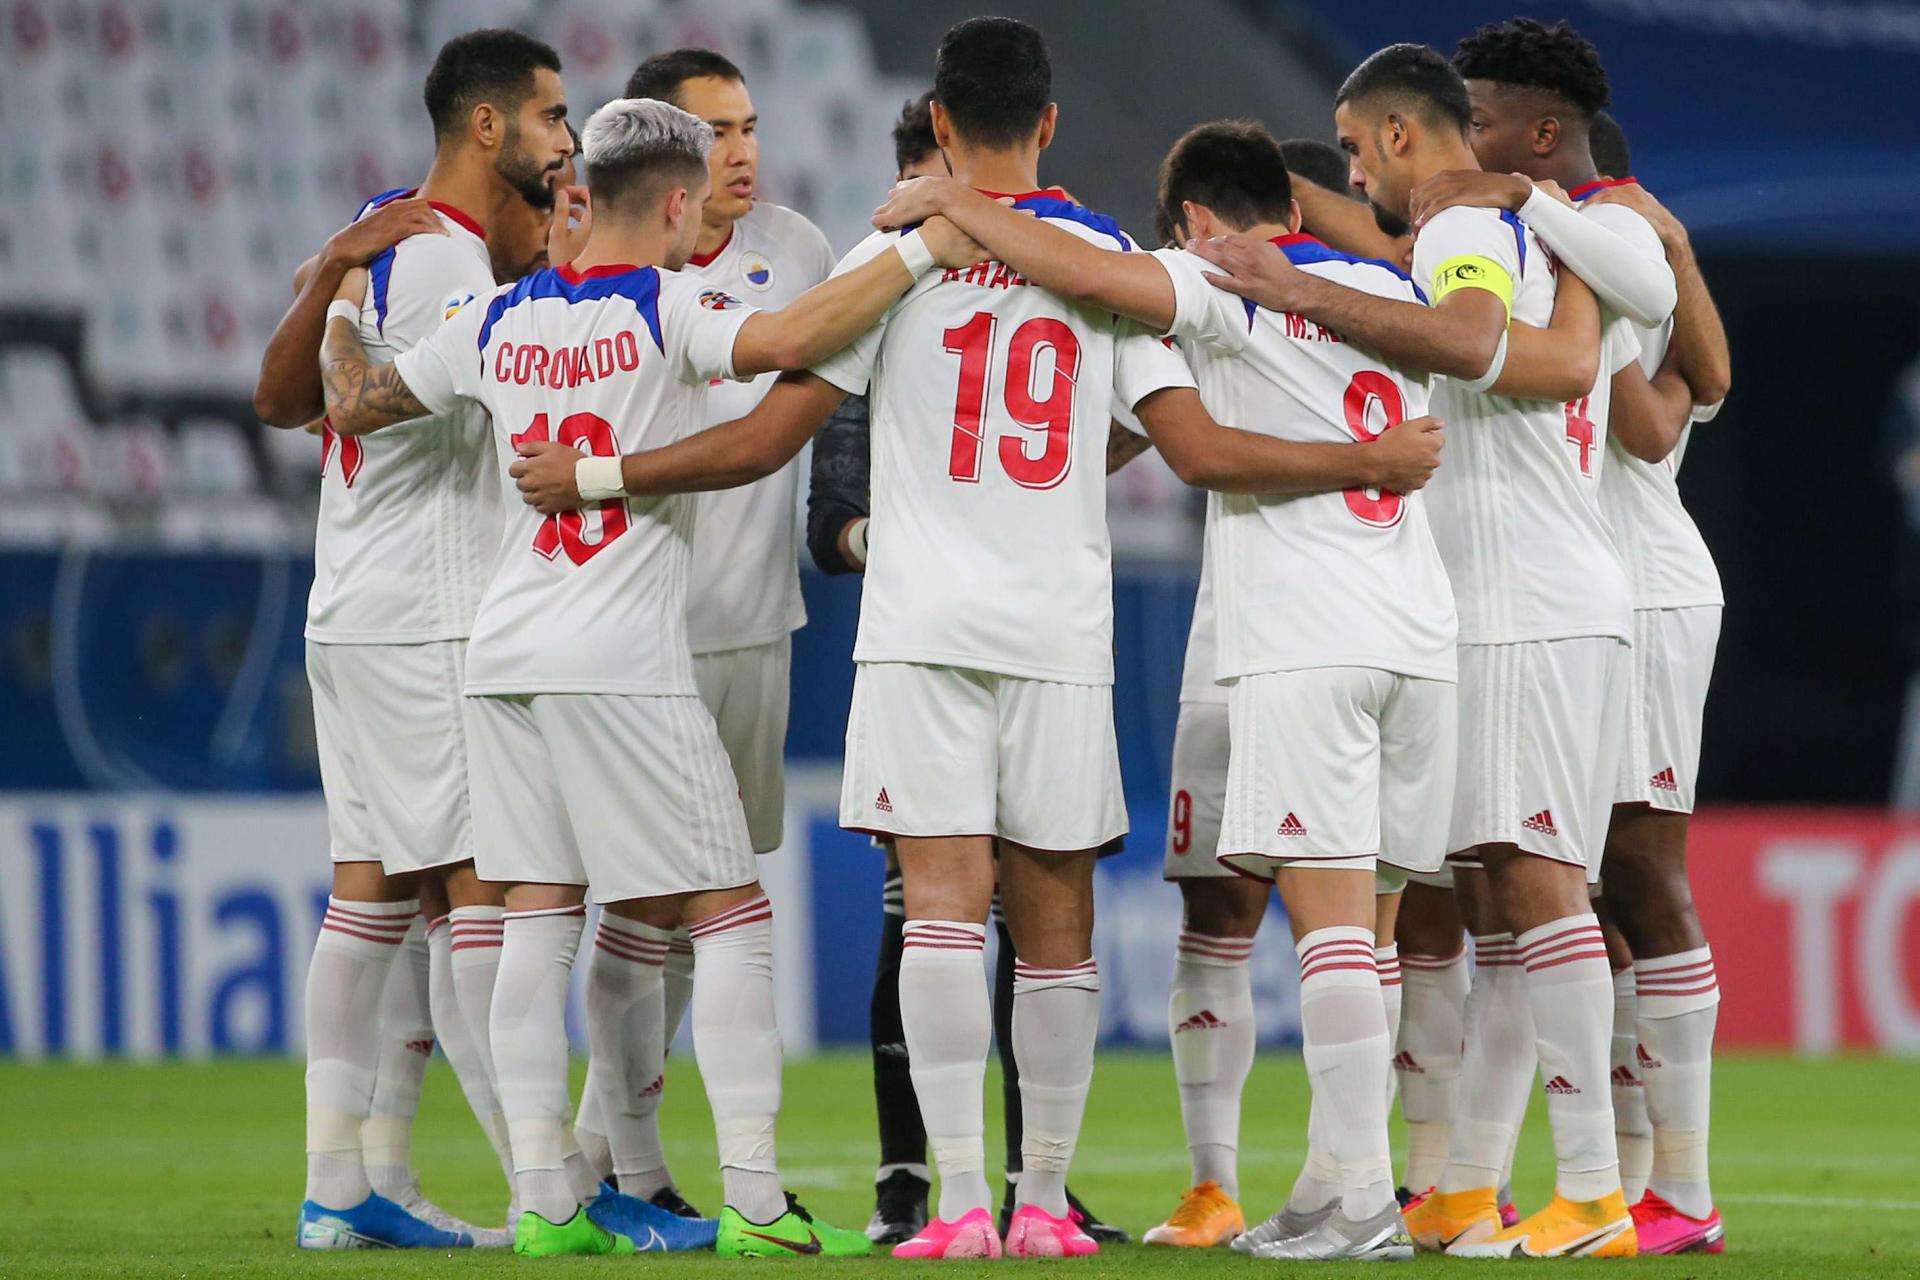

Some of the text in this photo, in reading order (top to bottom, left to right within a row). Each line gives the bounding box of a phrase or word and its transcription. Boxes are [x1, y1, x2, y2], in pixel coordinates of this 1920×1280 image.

[495, 330, 639, 390] CORONADO
[943, 311, 1082, 490] 19
[1565, 396, 1597, 479] 4
[1173, 789, 1192, 855] 9
[1522, 819, 1557, 837] adidas
[0, 822, 330, 1053] llia
